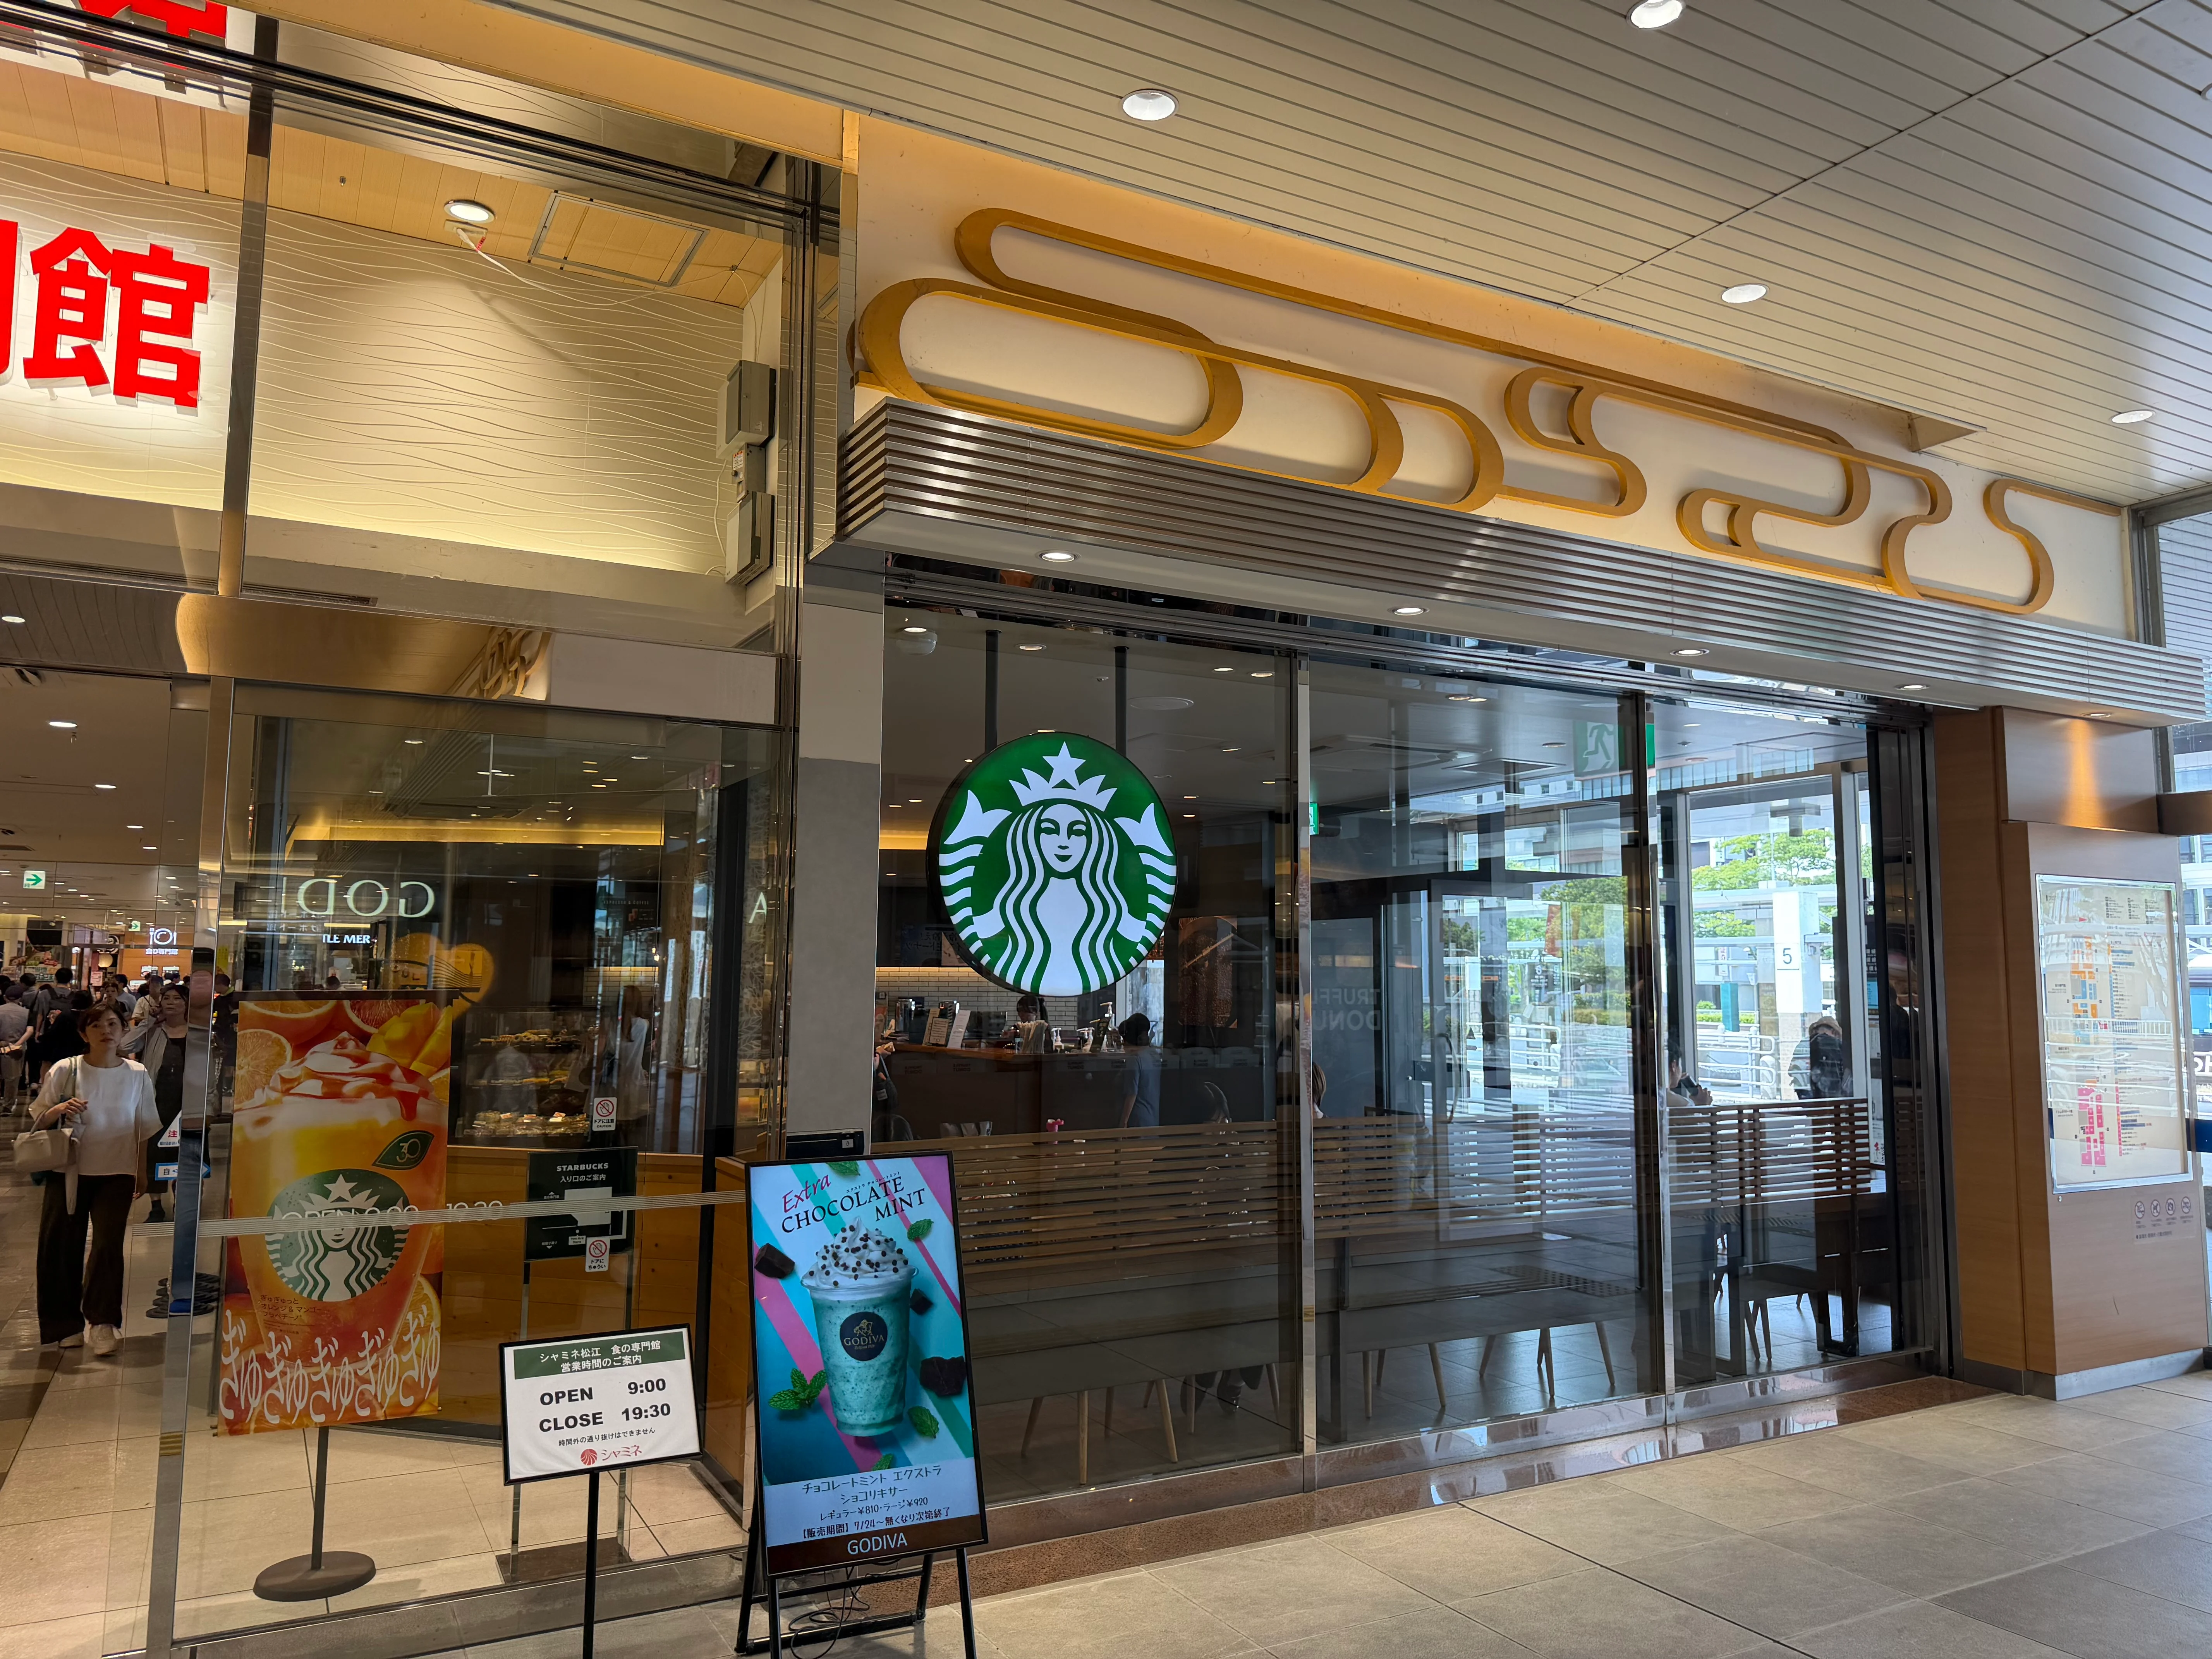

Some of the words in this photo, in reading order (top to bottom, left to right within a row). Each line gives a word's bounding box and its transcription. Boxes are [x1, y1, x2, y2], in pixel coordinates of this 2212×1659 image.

[1783, 948, 1792, 965] 5
[556, 1163, 609, 1171] STARBUCKS
[560, 1174, 606, 1183] 入り口のご案内
[782, 1175, 831, 1214] Extra
[781, 1176, 904, 1233] CHOCOLATE
[875, 1188, 925, 1221] MINT
[261, 1295, 299, 1304] ぎゅぎゅっと
[844, 1334, 884, 1346] GODIVA
[540, 1347, 601, 1362] シャミネ松江
[611, 1340, 661, 1354] 食の専門館
[561, 1354, 642, 1372] 営業時間のご案内
[540, 1387, 593, 1406] OPEN
[627, 1378, 666, 1395] 9:00
[539, 1412, 604, 1432] CLOSE
[621, 1403, 671, 1421] 19:30
[558, 1427, 655, 1446] 時間外の通り抜けはできません
[601, 1444, 642, 1462] シャミネ
[802, 1474, 886, 1494] チョコレートミント
[893, 1465, 941, 1481] エクストラ
[840, 1487, 908, 1504] ショコリキサー
[847, 1532, 907, 1555] GODIVA
